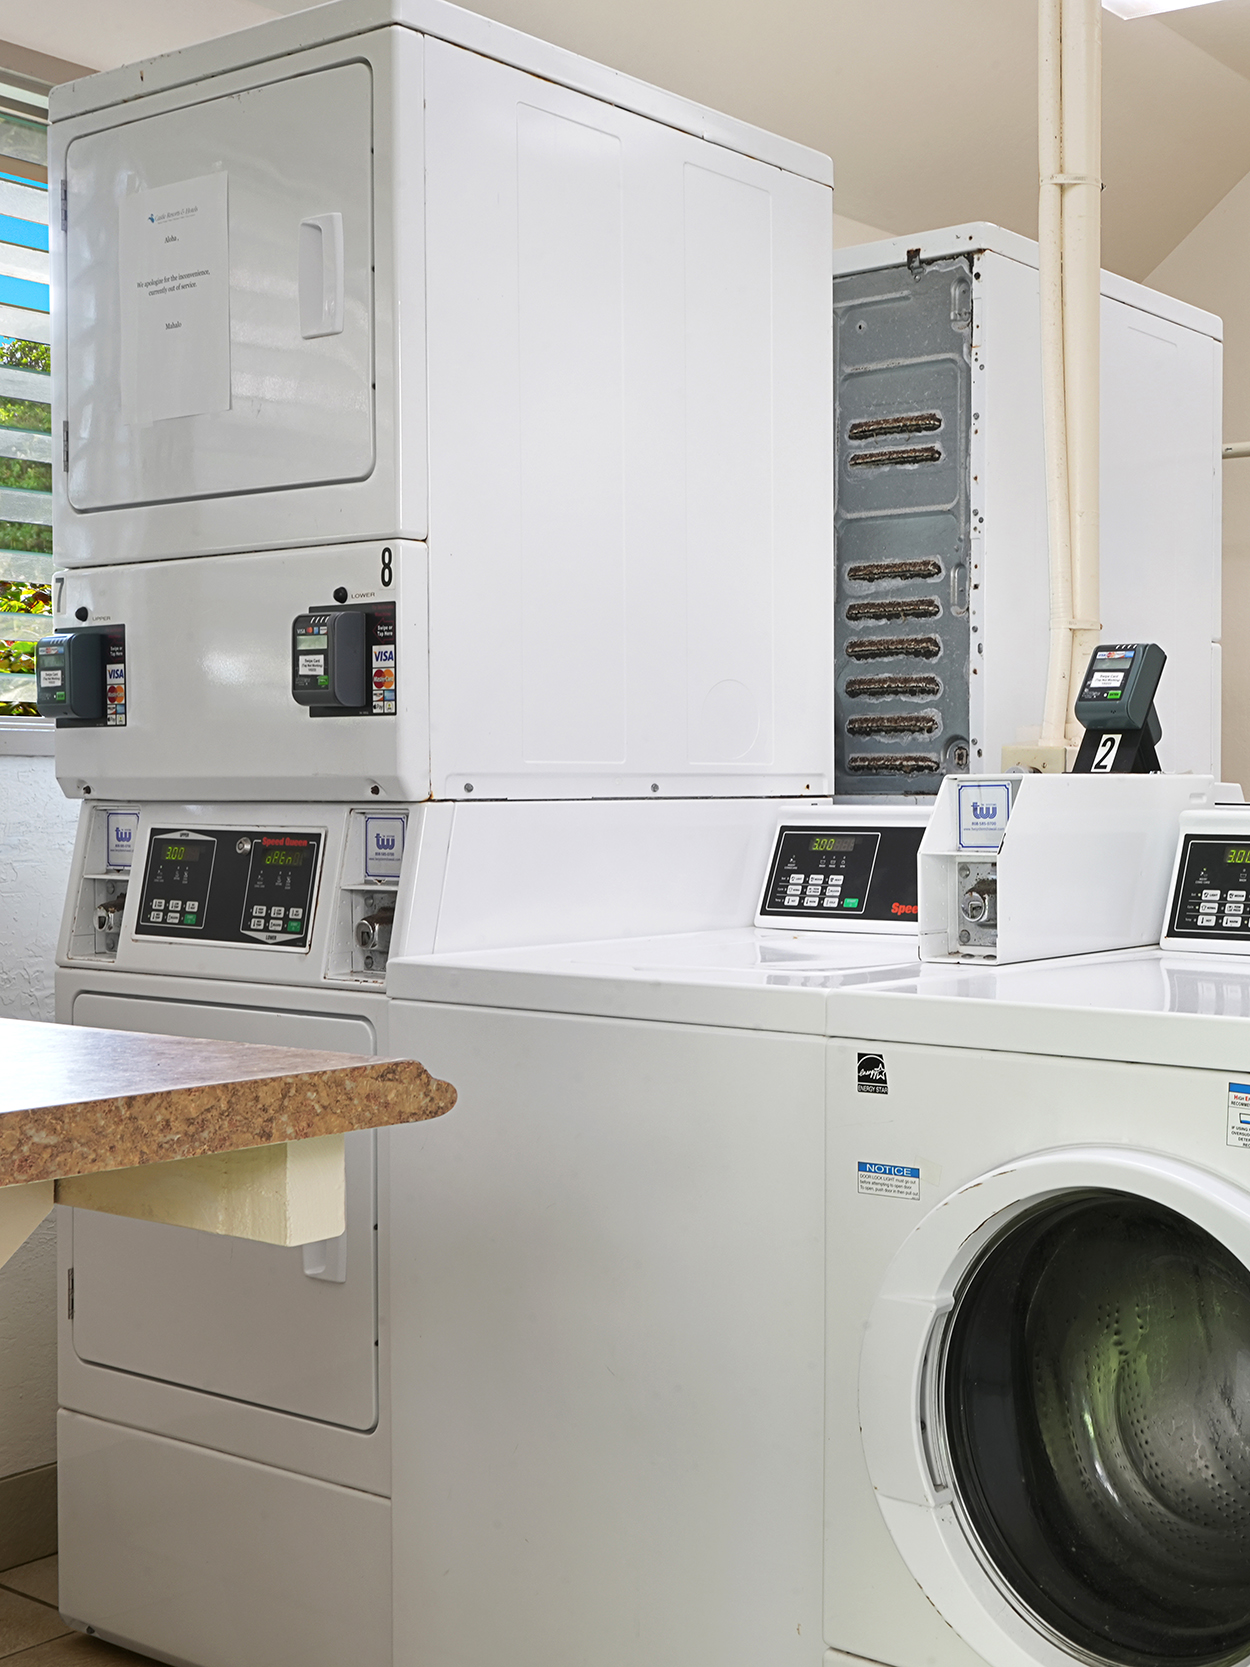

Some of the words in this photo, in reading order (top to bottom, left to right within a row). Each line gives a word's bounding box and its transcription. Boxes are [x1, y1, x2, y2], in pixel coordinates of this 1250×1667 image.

[144, 277, 163, 288] apologize
[178, 269, 211, 281] inconvenience,
[148, 286, 167, 296] currently
[181, 282, 197, 290] service.
[165, 321, 182, 330] Mahalo
[381, 547, 392, 587] 8
[55, 577, 64, 613] 7
[374, 650, 394, 662] VISA
[108, 669, 124, 679] VISA
[1094, 736, 1116, 769] 2
[971, 802, 997, 819] tw
[262, 836, 284, 847] Speed
[285, 837, 308, 846] Queen
[812, 838, 835, 851] 3.00
[165, 846, 185, 860] 3.00
[891, 902, 918, 915] Spee
[858, 1084, 875, 1093] ENERGY
[876, 1086, 888, 1094] STAR
[866, 1163, 911, 1177] NOTICE
